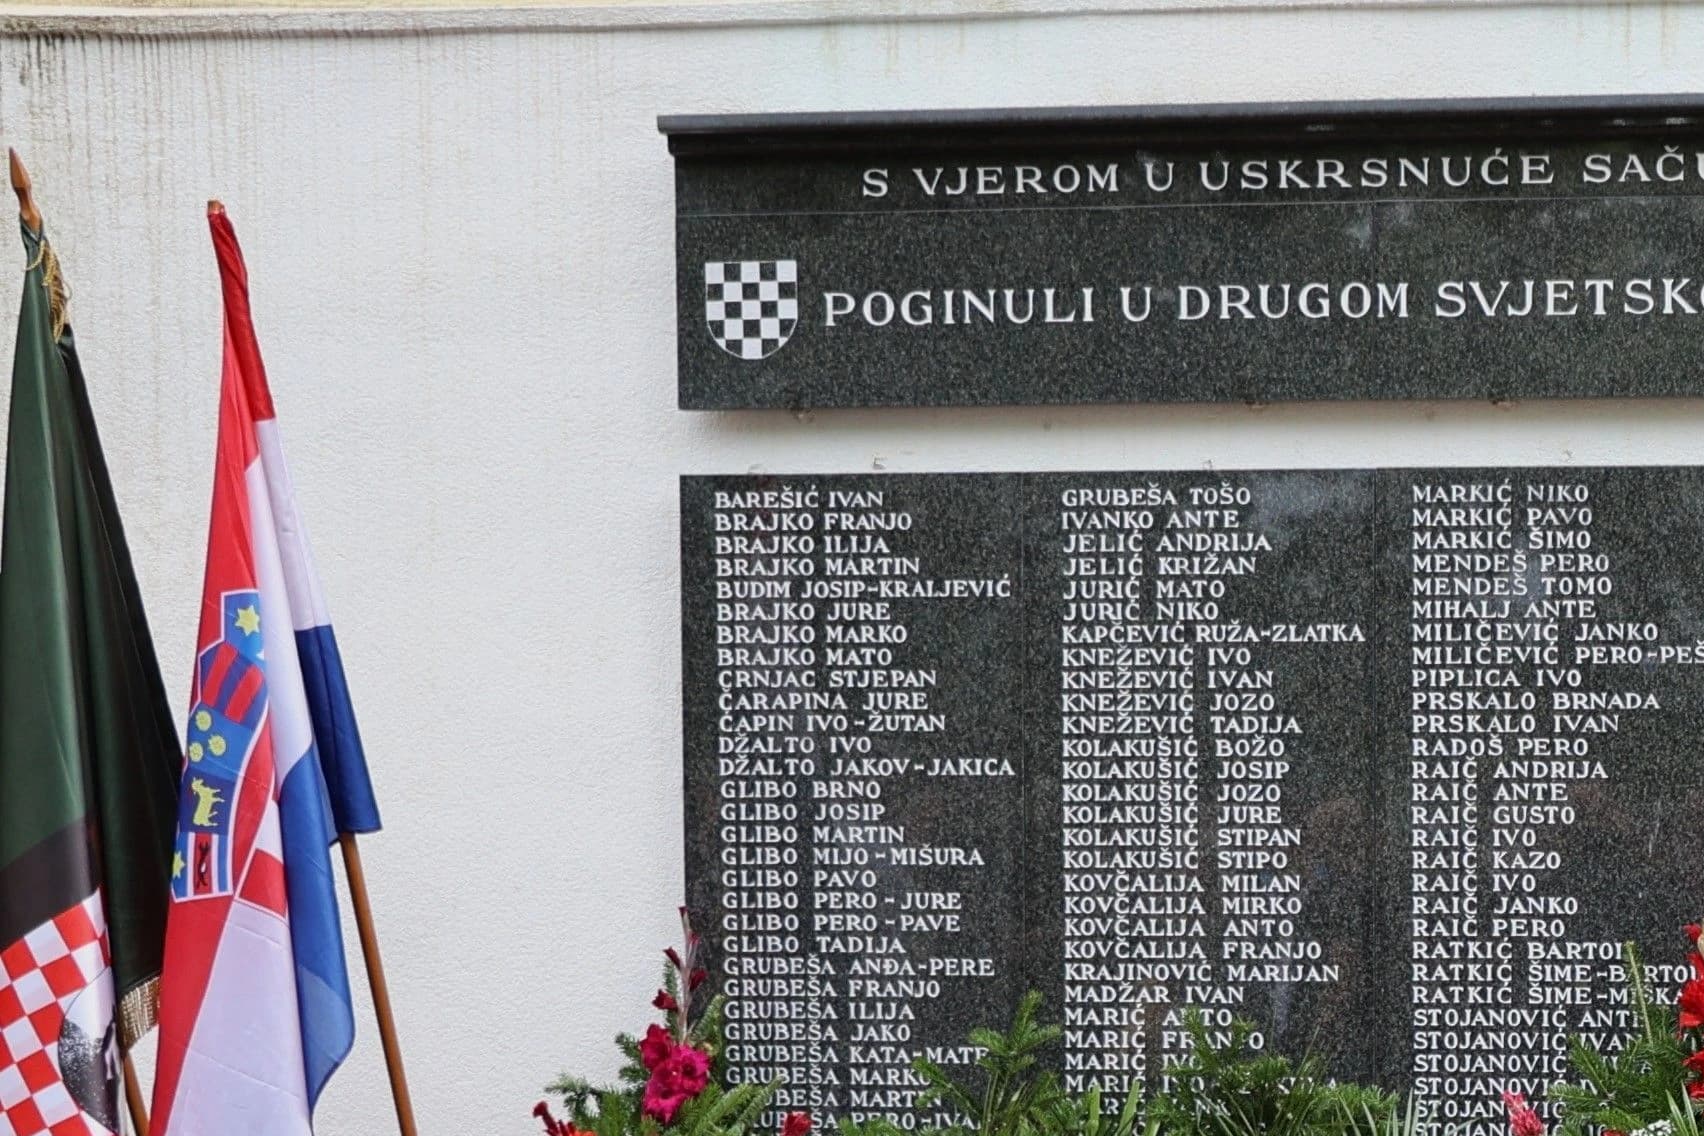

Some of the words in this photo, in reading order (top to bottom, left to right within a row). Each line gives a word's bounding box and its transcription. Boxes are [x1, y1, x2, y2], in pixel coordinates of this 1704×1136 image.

[864, 173, 889, 198] S
[915, 165, 1119, 196] VJEROM
[1146, 164, 1174, 193] U
[1202, 157, 1555, 192] USKRSNUĆE
[825, 288, 1095, 328] POGINULI
[1121, 287, 1152, 323] U
[1179, 283, 1410, 321] DRUGOM
[714, 485, 819, 509] BAREŠIĆ
[828, 491, 883, 508] IVAN
[1061, 482, 1177, 506] GRUBEŠA
[1188, 481, 1253, 505] TOŠO
[714, 513, 814, 531] BRAJKO
[824, 512, 913, 531] FRANJO
[1412, 502, 1512, 527] MARKIĆ
[1526, 507, 1593, 526] PAVO
[1062, 527, 1143, 553] JELIĆ
[1155, 532, 1277, 552] ANDRIJA
[716, 580, 792, 599] BUDIM
[801, 573, 1011, 598] JOSIP-KRALJEVIĆ
[1412, 600, 1510, 619] MIHALJ
[1523, 599, 1597, 619] ANTE
[1062, 618, 1185, 644] KAPČEVIĆ
[1195, 618, 1366, 643] RUŽA-ZLATKA
[1412, 617, 1559, 642] MILIČEVIĆ
[1574, 622, 1659, 641] JANKO
[717, 647, 816, 666] BRAJKO
[826, 647, 893, 666] MATO
[718, 670, 816, 688] CRNJAC
[828, 669, 936, 688] STJEPAN
[1061, 664, 1194, 689] KNEŽEVIĆ
[1207, 670, 1274, 689] IVAN
[718, 686, 849, 710] ČARAPINA
[862, 692, 929, 711] JURE
[1412, 691, 1536, 710] PRSKALO
[1552, 692, 1661, 710] BRNADA
[1062, 732, 1199, 757] KOLAKUŠIĆ
[1215, 732, 1285, 757] BOŽO
[1412, 732, 1504, 757] RADOŠ
[1517, 737, 1589, 756] PERO
[1411, 799, 1478, 825] RAIČ
[1492, 805, 1576, 825] GUSTO
[720, 825, 798, 843] GLIBO
[812, 825, 905, 844] MARTIN
[1063, 844, 1199, 869] KOLAKUŠIĆ
[1217, 850, 1288, 869] STIPO
[1412, 890, 1478, 915] RAIČ
[1493, 896, 1579, 915] JANKO
[1064, 912, 1207, 937] KOVČALIJA
[1222, 918, 1294, 937] ANTO
[722, 935, 799, 953] GLIBO
[815, 936, 906, 954] TADIJA
[1064, 957, 1212, 981] KRAJINOVIĆ
[1227, 964, 1340, 982] MARIJAN
